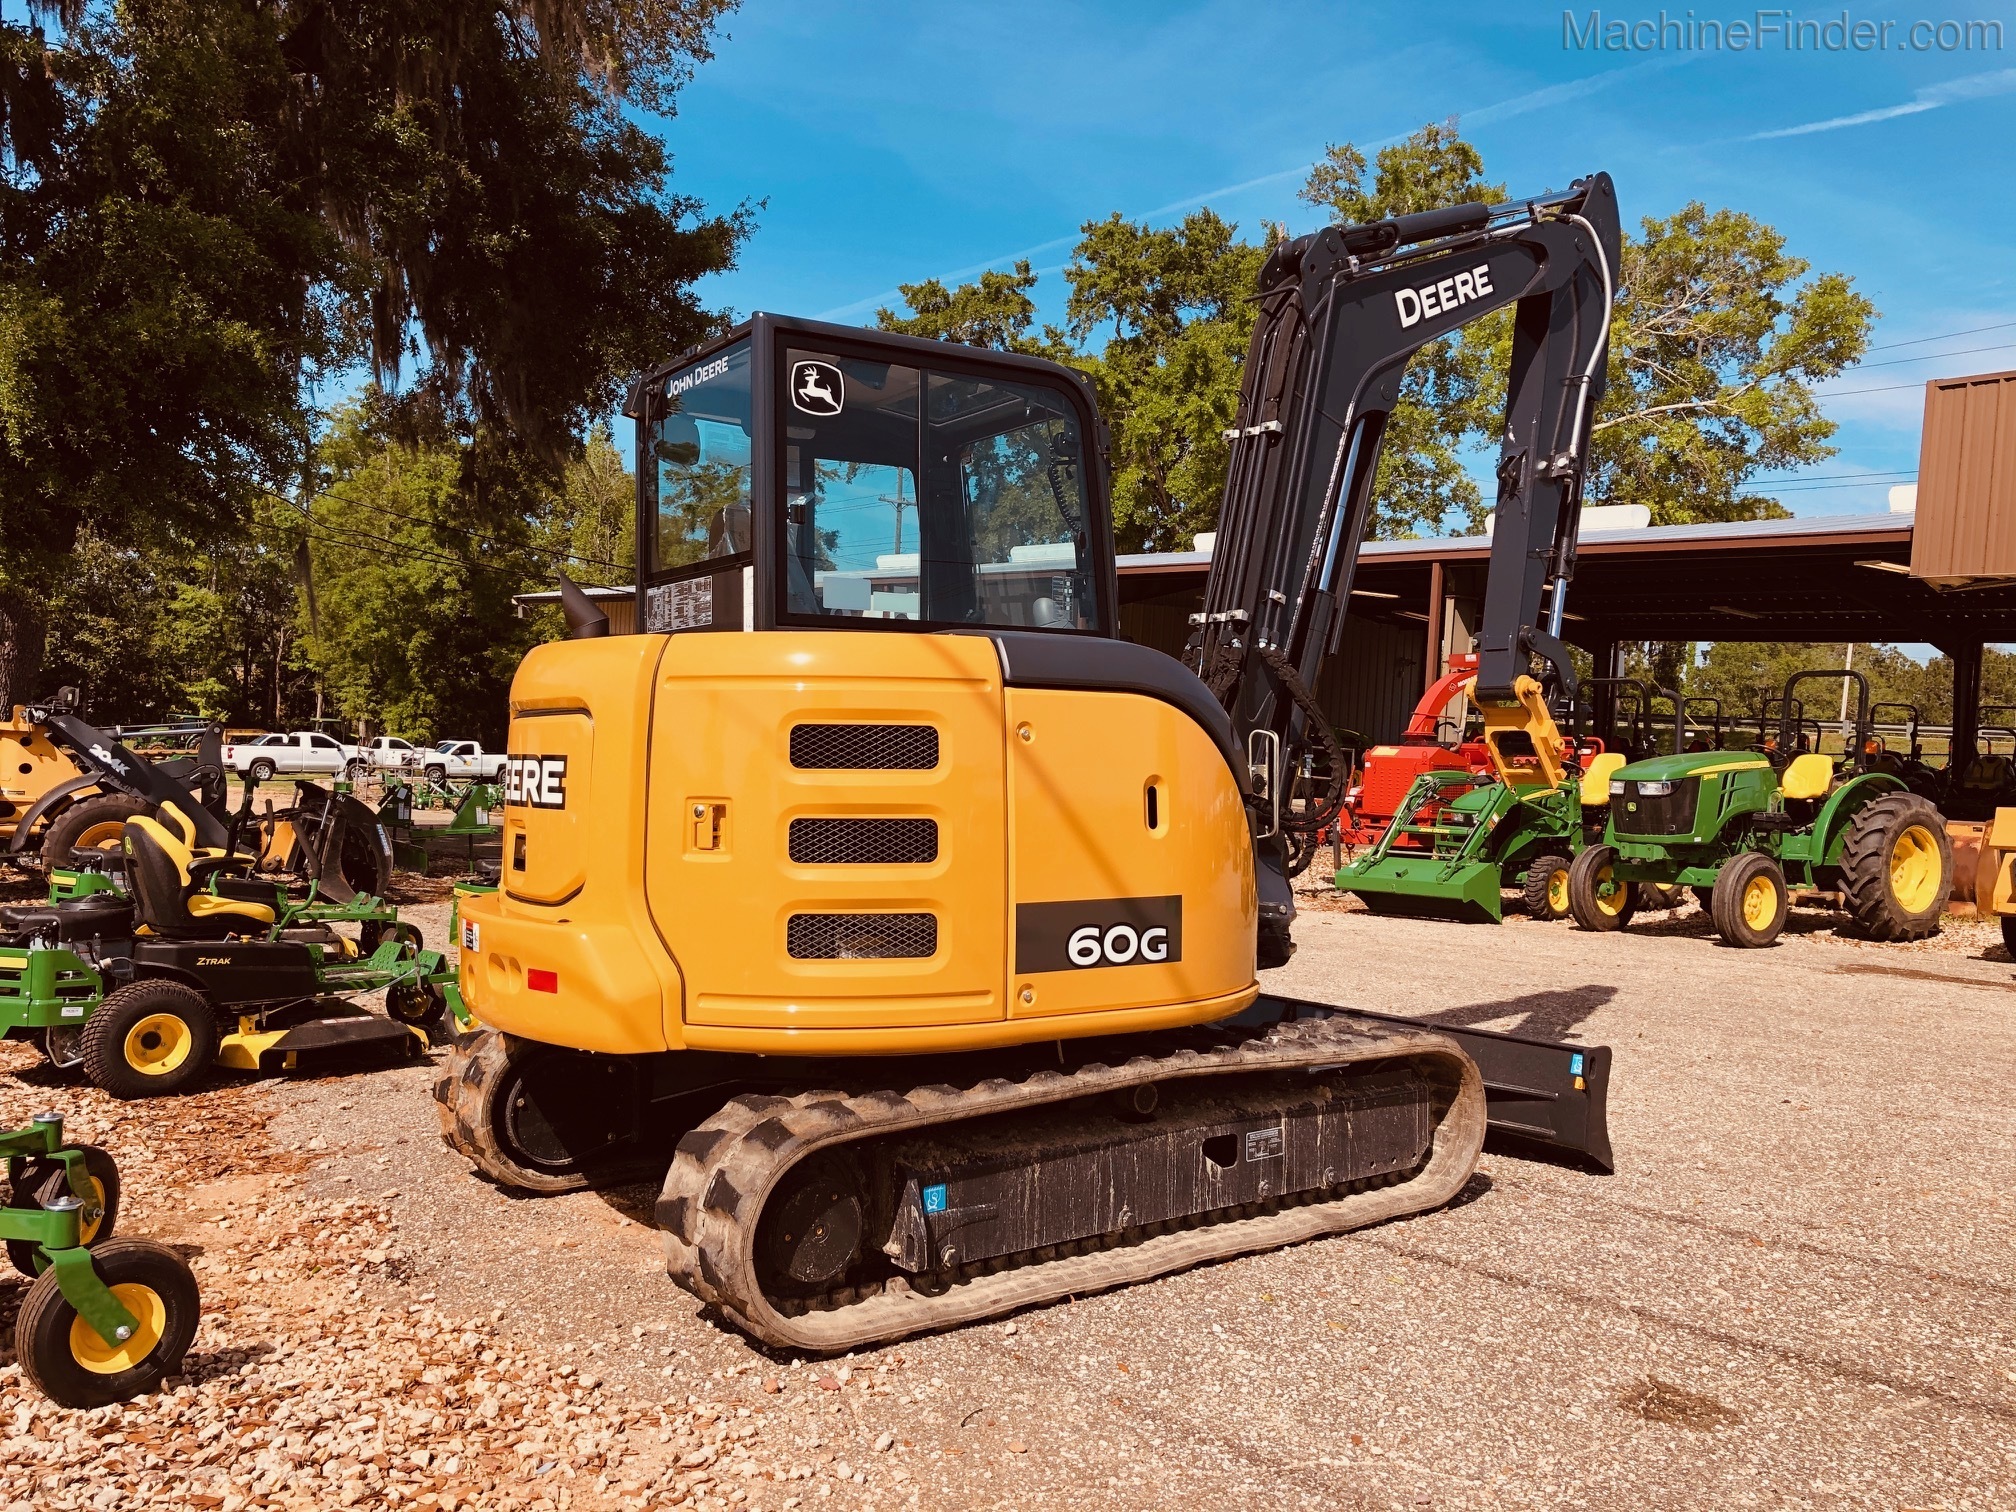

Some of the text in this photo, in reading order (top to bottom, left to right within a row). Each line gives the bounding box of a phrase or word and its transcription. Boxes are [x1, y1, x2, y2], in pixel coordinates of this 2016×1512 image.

[1394, 263, 1494, 329] DEERE
[667, 355, 729, 399] JOHN DEERE
[505, 758, 566, 804] EERE
[196, 957, 232, 966] ZTRAK
[1067, 925, 1168, 966] 60G
